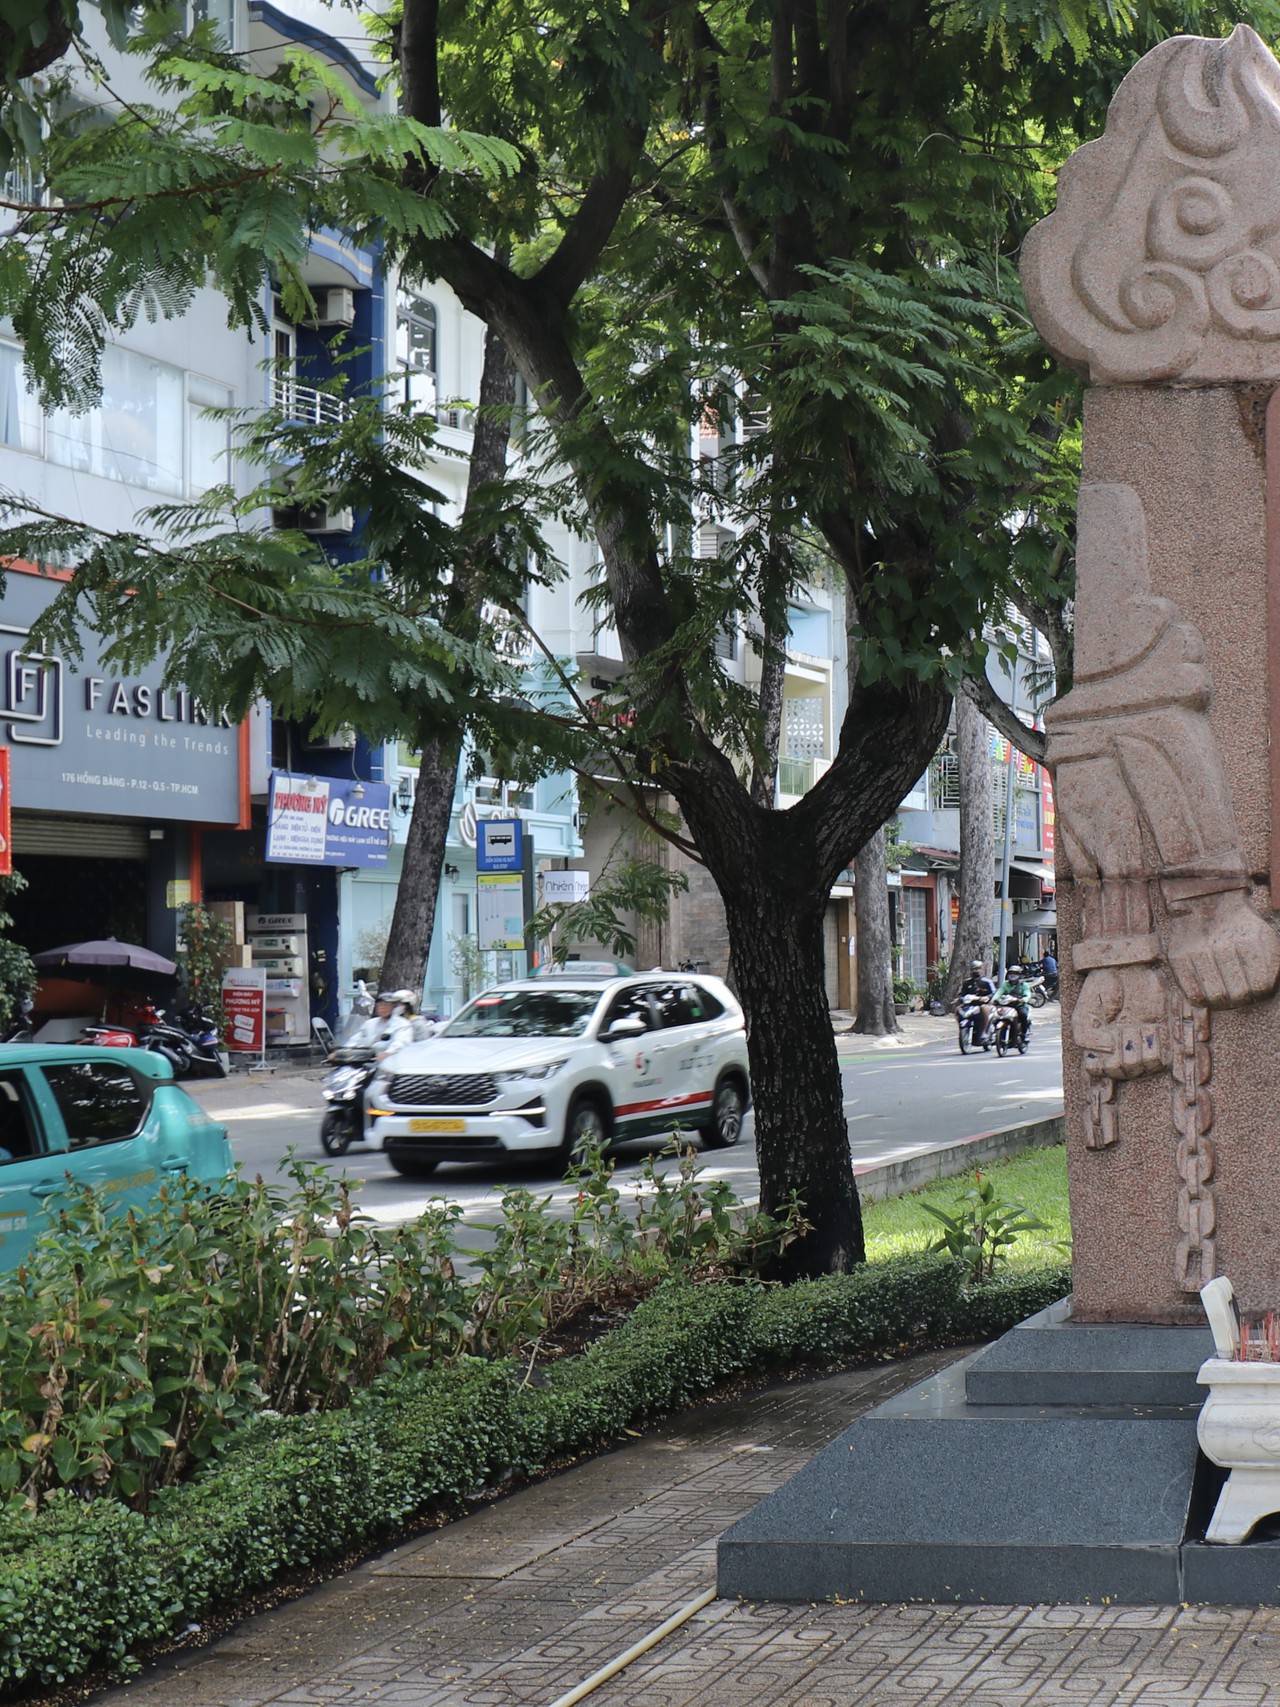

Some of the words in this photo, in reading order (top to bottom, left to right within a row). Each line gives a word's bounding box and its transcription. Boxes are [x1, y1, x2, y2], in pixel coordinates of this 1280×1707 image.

[86, 724, 146, 748] Leading
[154, 734, 177, 748] the
[184, 737, 229, 756] Trends
[61, 772, 76, 783] 176
[170, 783, 199, 794] TP.HCM
[345, 805, 390, 830] GREE
